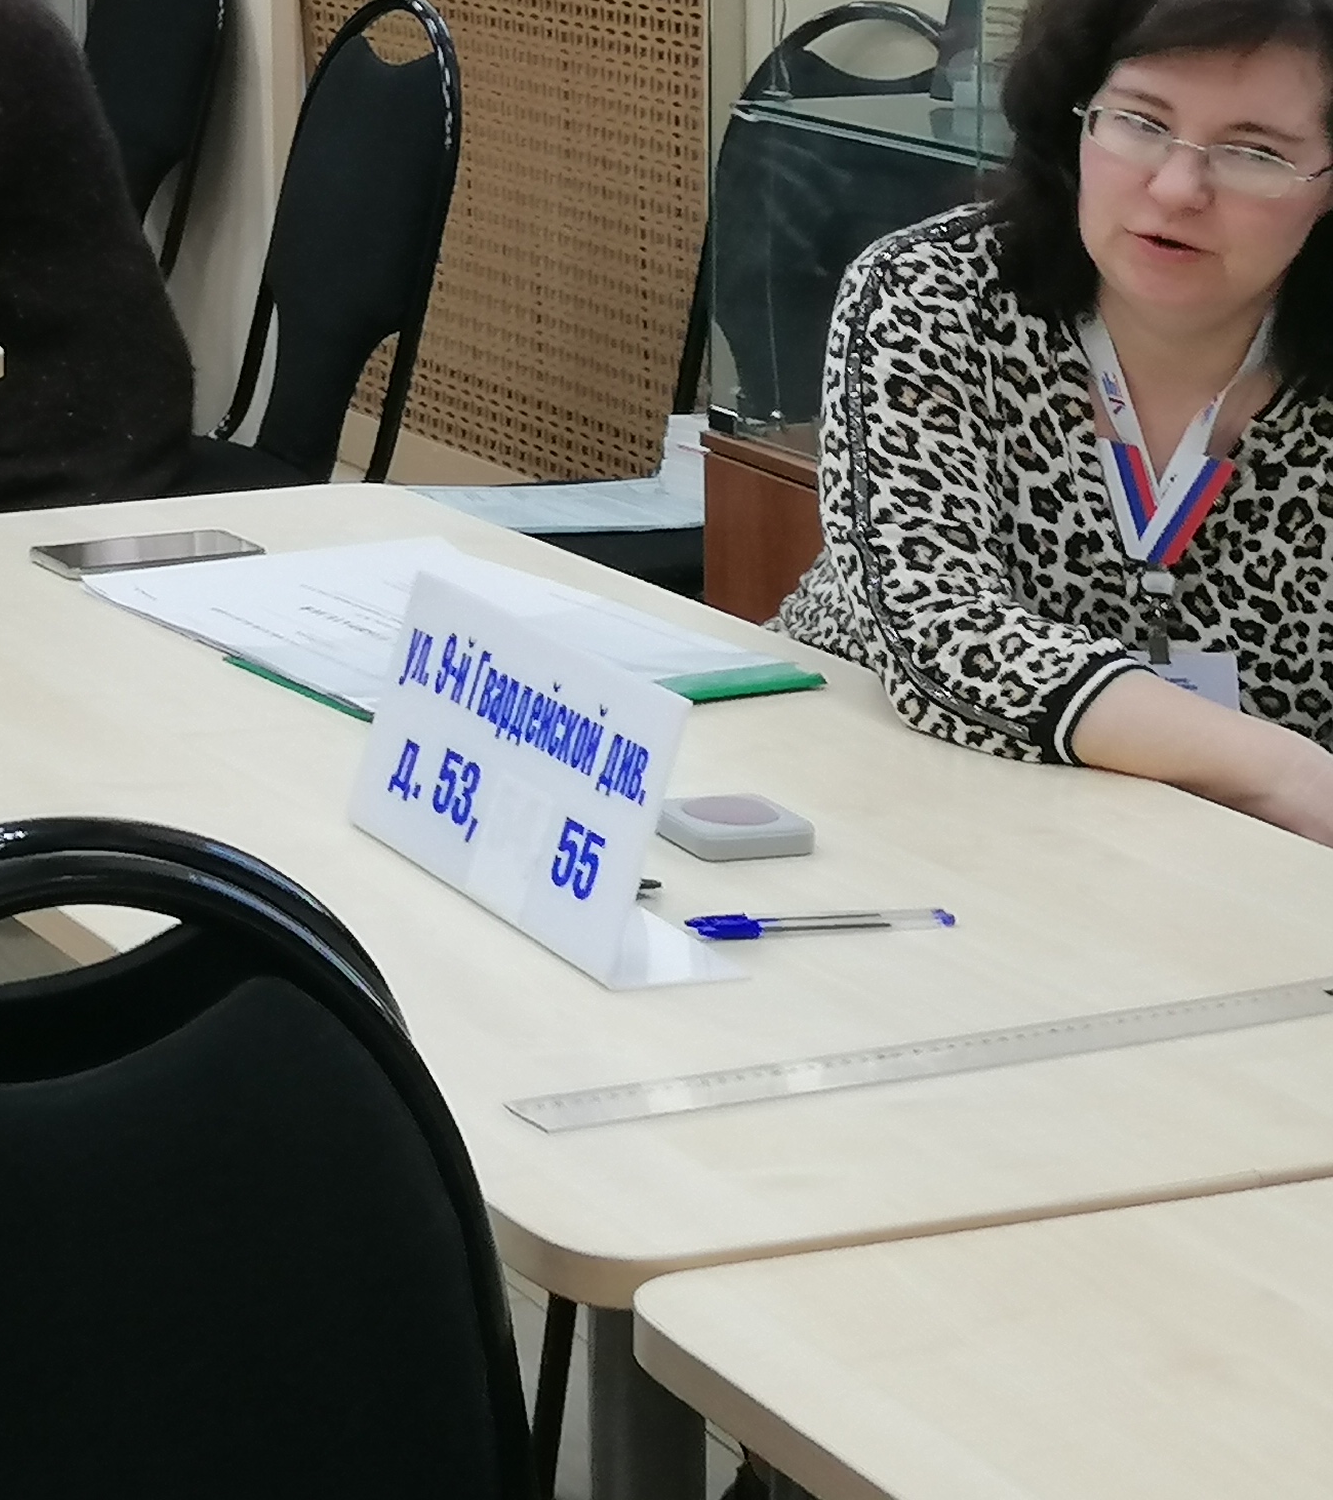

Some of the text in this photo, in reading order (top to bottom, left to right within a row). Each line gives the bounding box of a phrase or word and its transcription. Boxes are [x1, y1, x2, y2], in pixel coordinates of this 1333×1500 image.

[399, 628, 650, 807] ул. 9-й Гвардейской див.
[387, 739, 606, 900] д. 53, 55
